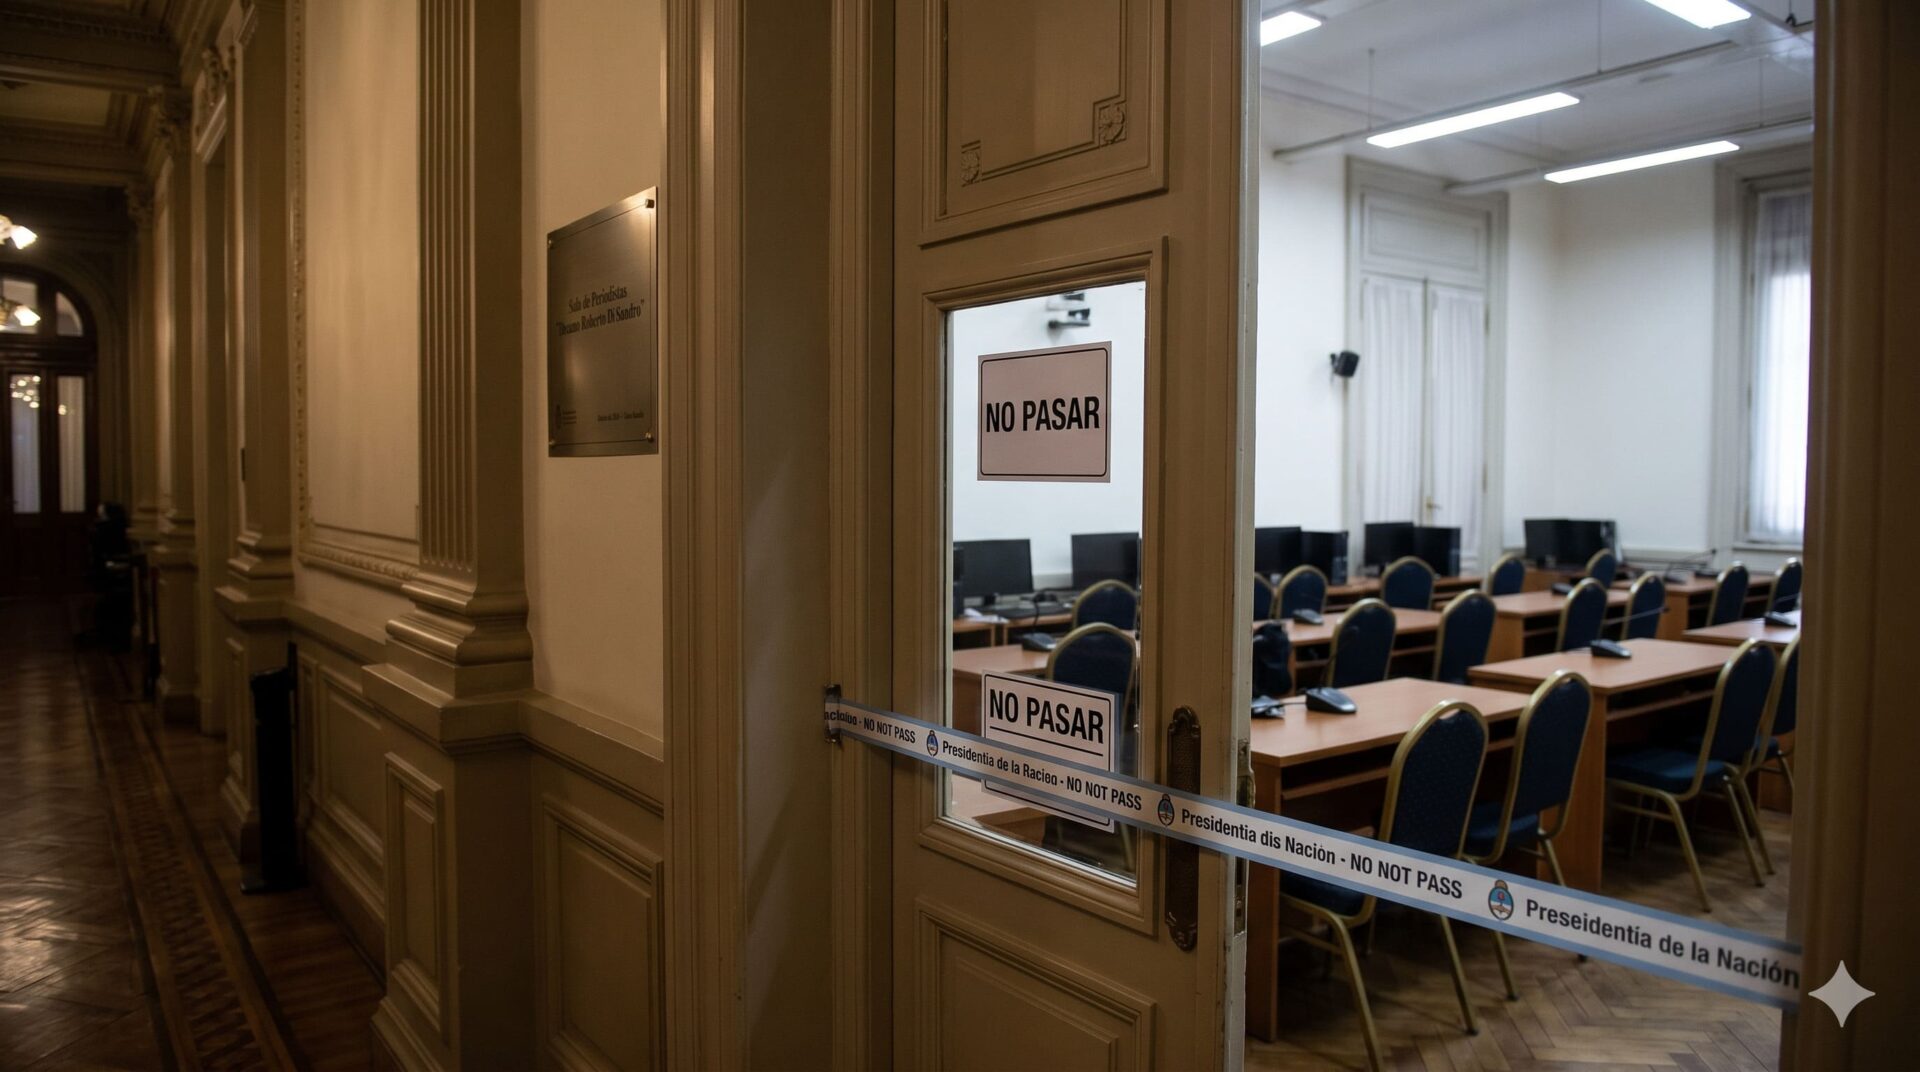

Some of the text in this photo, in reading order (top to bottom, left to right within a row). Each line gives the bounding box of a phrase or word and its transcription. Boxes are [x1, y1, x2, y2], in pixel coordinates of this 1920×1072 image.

[582, 295, 591, 310] de
[591, 285, 627, 307] Periodistas
[607, 308, 616, 324] Di
[986, 396, 1100, 433] NO PASAR
[989, 688, 1104, 744] NO PASAR
[863, 717, 875, 731] NO
[876, 721, 892, 737] NOT
[894, 728, 916, 744] PASS
[943, 740, 994, 767] Presidentia
[997, 757, 1009, 771] de
[1011, 760, 1020, 775] la
[1067, 775, 1082, 793] NO
[1085, 780, 1108, 801] NOT
[1111, 788, 1142, 811] PASS
[1181, 808, 1257, 843] Presidentia
[1260, 830, 1281, 849] dis
[1350, 853, 1373, 875] NO
[1378, 863, 1412, 885] NOT
[1417, 870, 1463, 899] PASS
[1658, 934, 1684, 957] de
[1690, 941, 1710, 964] la
[1717, 947, 1800, 990] Nación
